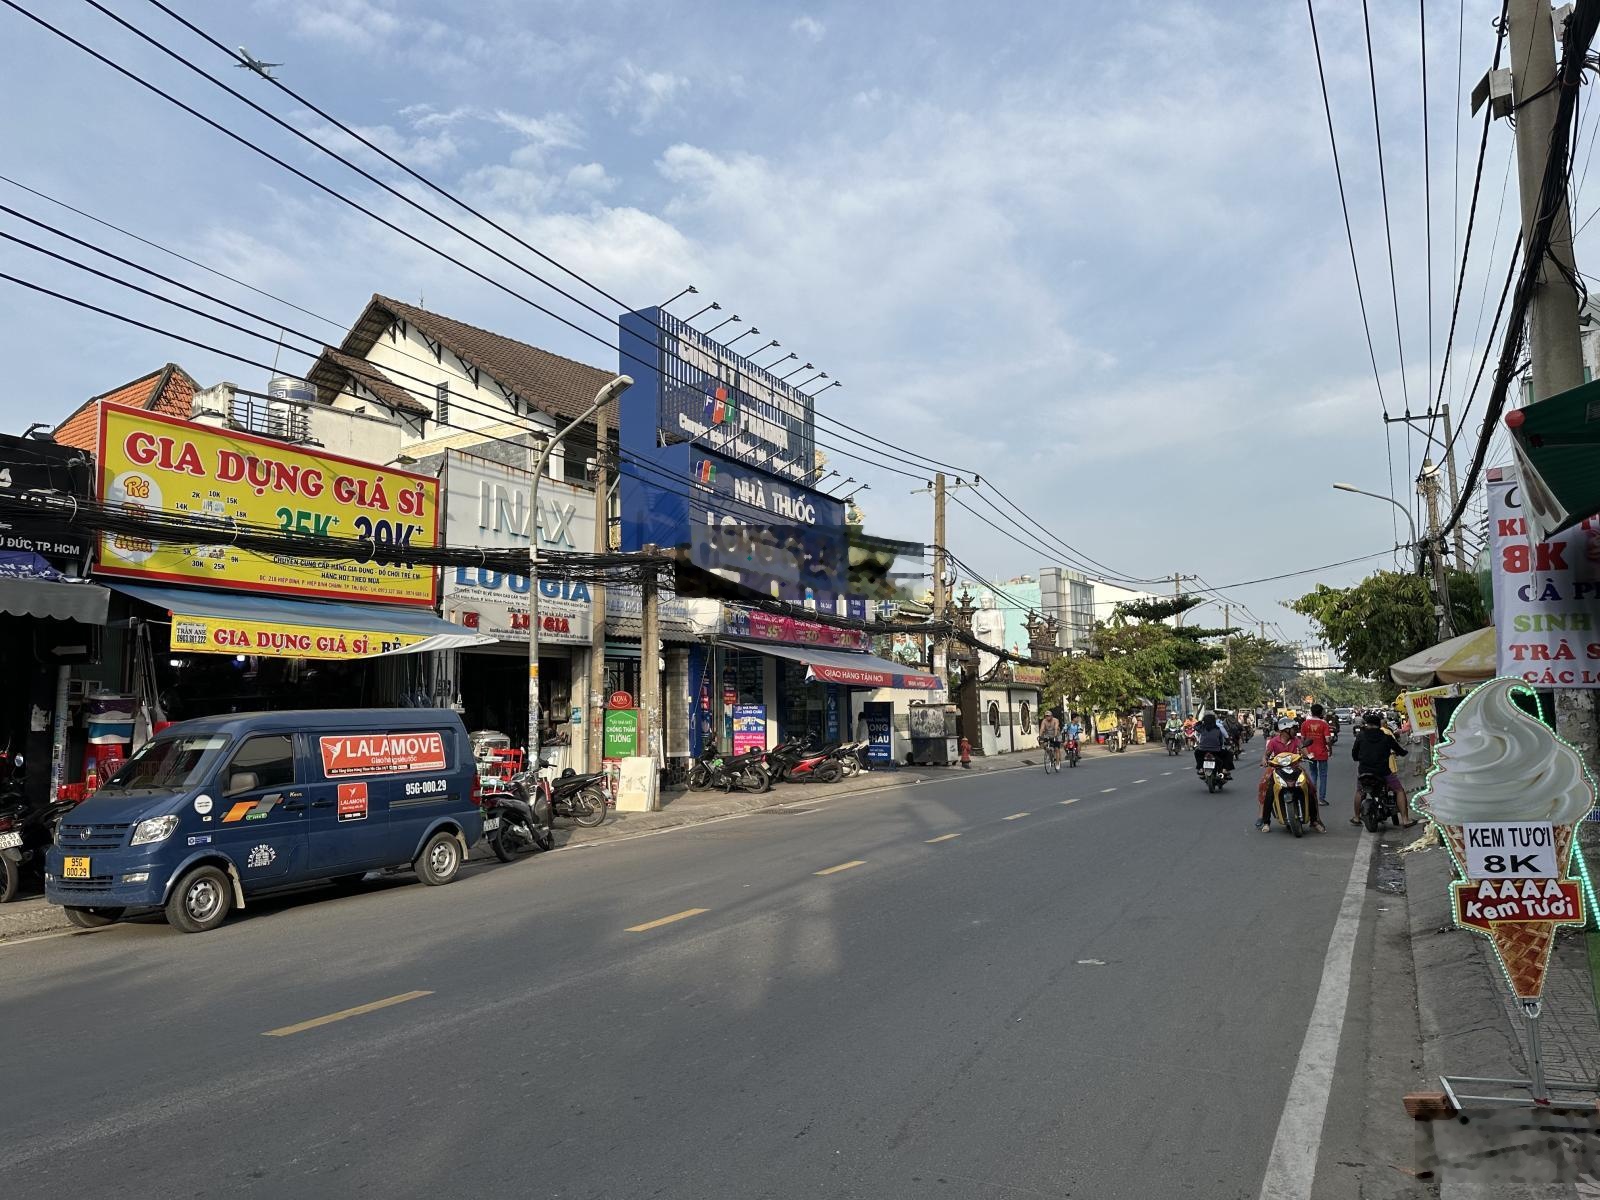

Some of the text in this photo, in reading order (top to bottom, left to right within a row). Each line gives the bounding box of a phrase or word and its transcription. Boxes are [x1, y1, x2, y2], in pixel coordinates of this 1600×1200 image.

[124, 432, 425, 516] GIA DỤNG GIÁ SỈ
[176, 502, 187, 510] 14K
[735, 478, 815, 525] NHÀ THUỐC
[479, 480, 576, 548] INAX
[7, 537, 79, 554] ĐỨC, TP. HCM
[1503, 542, 1568, 573] 8K
[1518, 578, 1562, 602] CÀ
[543, 616, 570, 633] GIA
[1513, 613, 1592, 633] SINH
[213, 628, 251, 647] GIA
[256, 631, 311, 653] DỤNG
[316, 633, 348, 653] GIÁ
[352, 634, 369, 653] SỈ
[1509, 639, 1576, 660] TRÀ
[824, 669, 841, 677] GIAO
[842, 670, 860, 680] HÀNG
[861, 673, 873, 683] TẬN
[1523, 667, 1600, 683] CÁC L
[346, 737, 440, 758] LALAMOVE
[406, 780, 446, 795] 95G-000.29
[340, 798, 366, 806] LALAMOVE
[1469, 827, 1551, 847] KEM TƯƠI
[67, 868, 86, 876] 000.29
[71, 859, 83, 867] 95G
[1484, 855, 1541, 873] 8K
[1467, 896, 1573, 919] Kem Tươi
